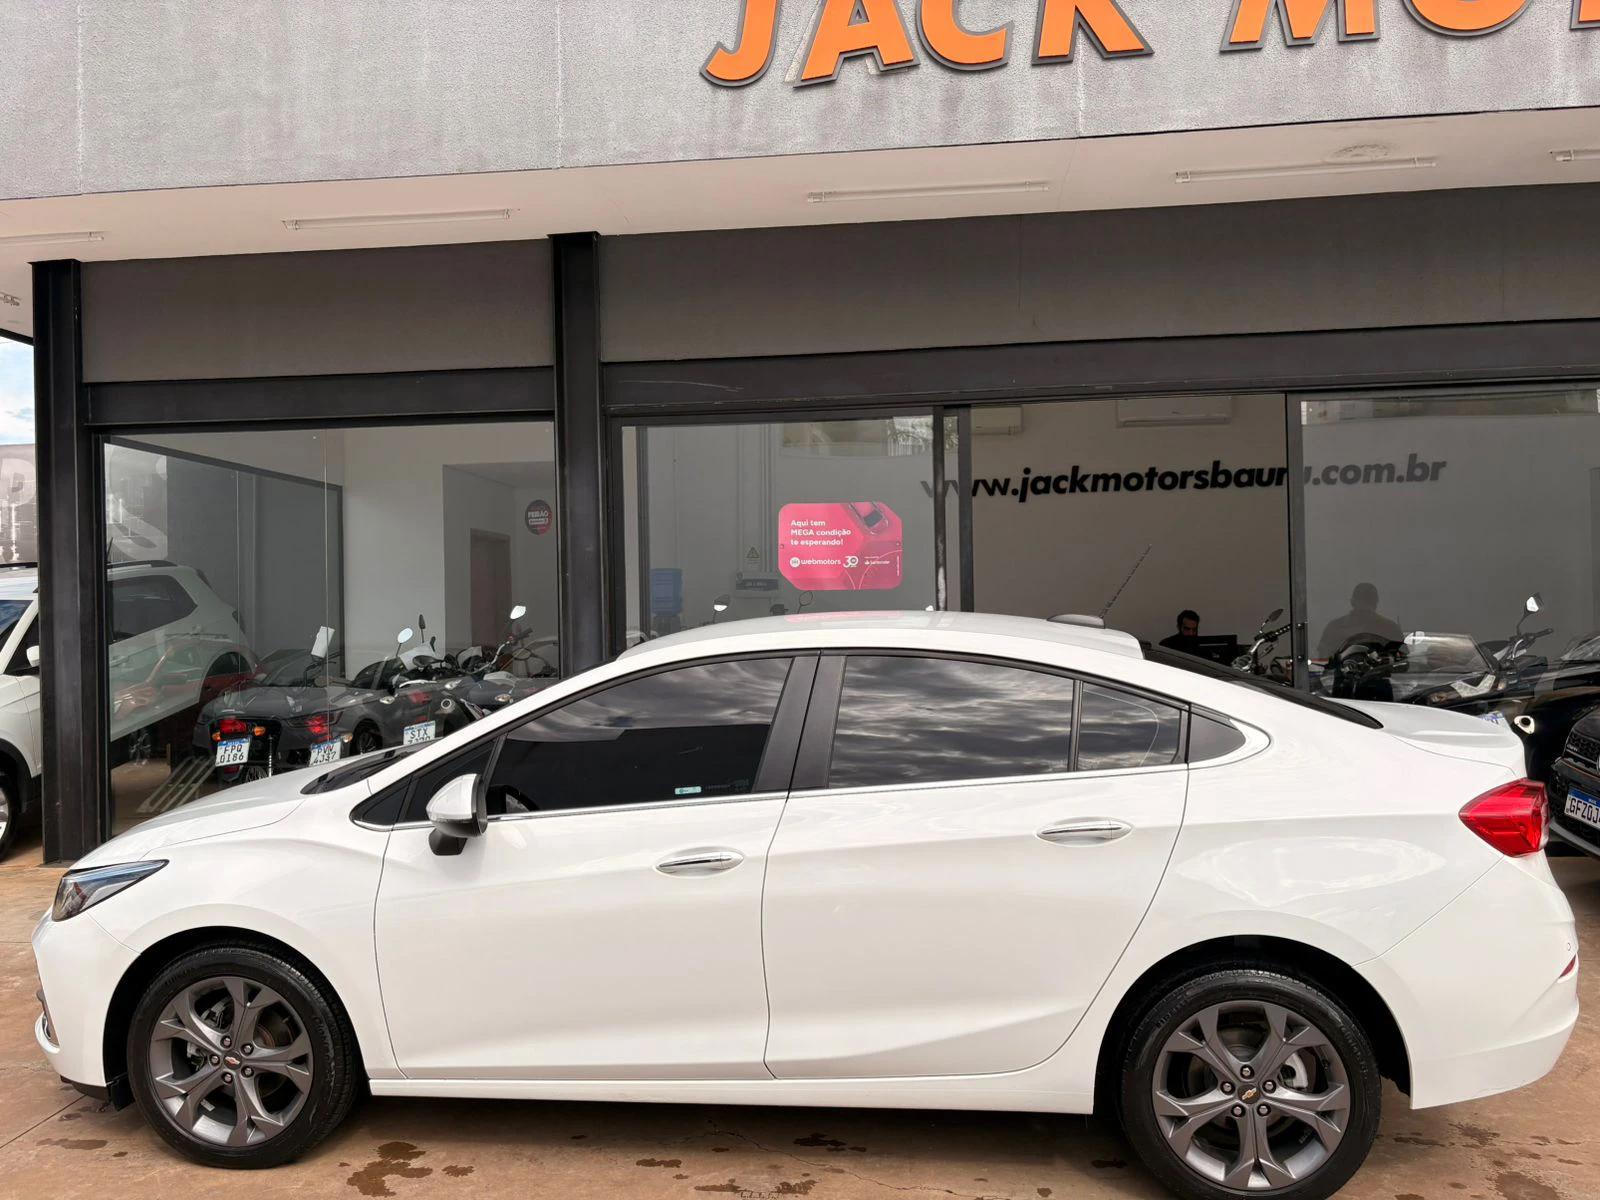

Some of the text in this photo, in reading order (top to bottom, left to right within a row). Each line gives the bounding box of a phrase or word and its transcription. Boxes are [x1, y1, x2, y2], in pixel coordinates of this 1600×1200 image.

[791, 519, 809, 527] Aqui
[816, 528, 852, 538] condição
[800, 538, 844, 547] esperando!
[1569, 797, 1600, 824] GFZ0J
